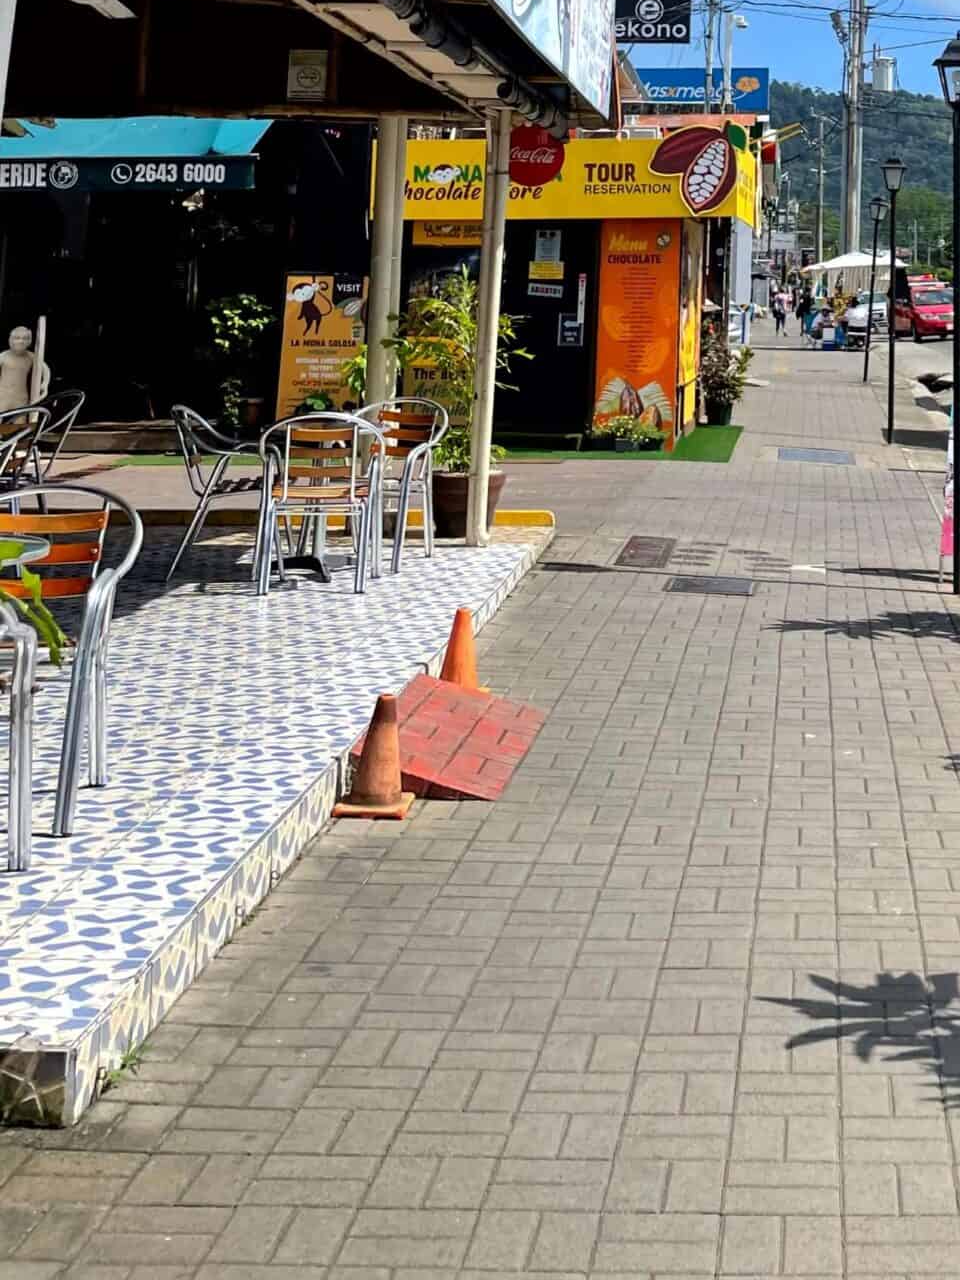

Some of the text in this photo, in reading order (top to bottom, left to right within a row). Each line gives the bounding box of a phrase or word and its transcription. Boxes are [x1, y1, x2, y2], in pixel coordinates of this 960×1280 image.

[615, 21, 687, 38] ekono
[135, 164, 178, 183] 2643
[183, 164, 226, 183] 6000
[584, 163, 636, 182] TOUR
[404, 178, 482, 201] hocolate
[583, 183, 671, 195] RESERVATION
[607, 231, 648, 251] Menu
[607, 254, 662, 264] CHOCOLATE
[336, 283, 361, 292] VISIT
